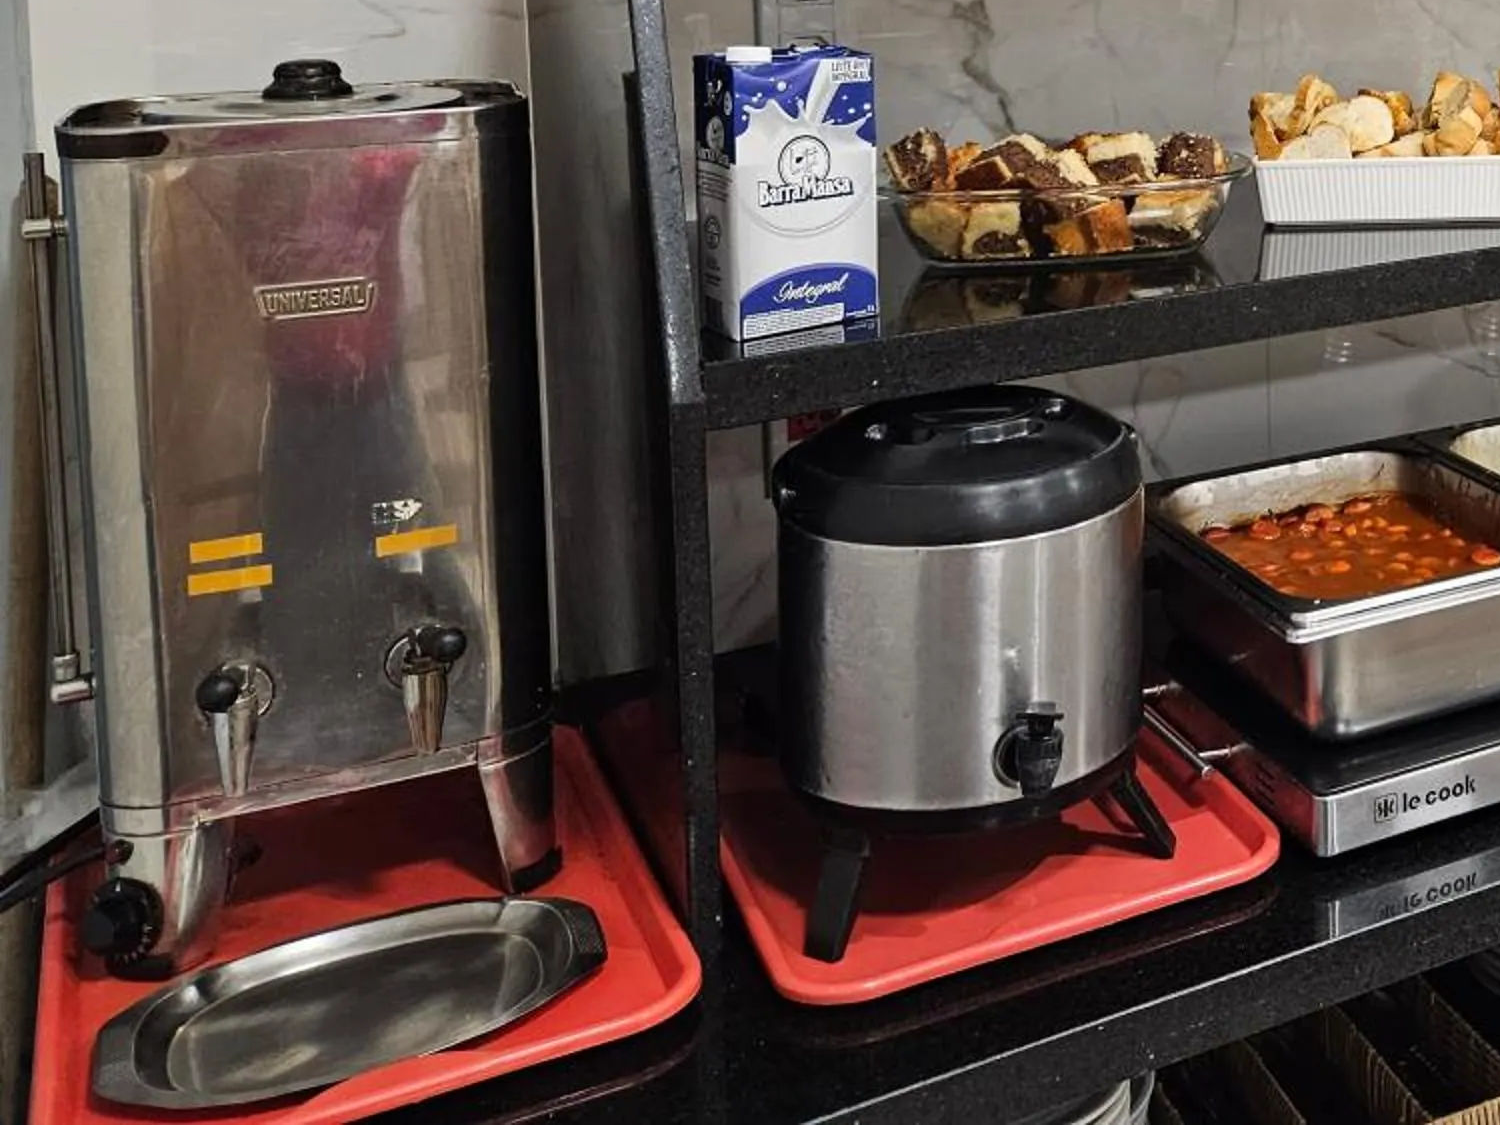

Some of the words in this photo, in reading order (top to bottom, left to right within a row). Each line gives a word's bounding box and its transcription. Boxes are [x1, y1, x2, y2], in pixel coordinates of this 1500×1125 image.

[263, 284, 365, 313] UNIVERSAL
[1402, 792, 1421, 813] le
[1425, 774, 1476, 805] cook
